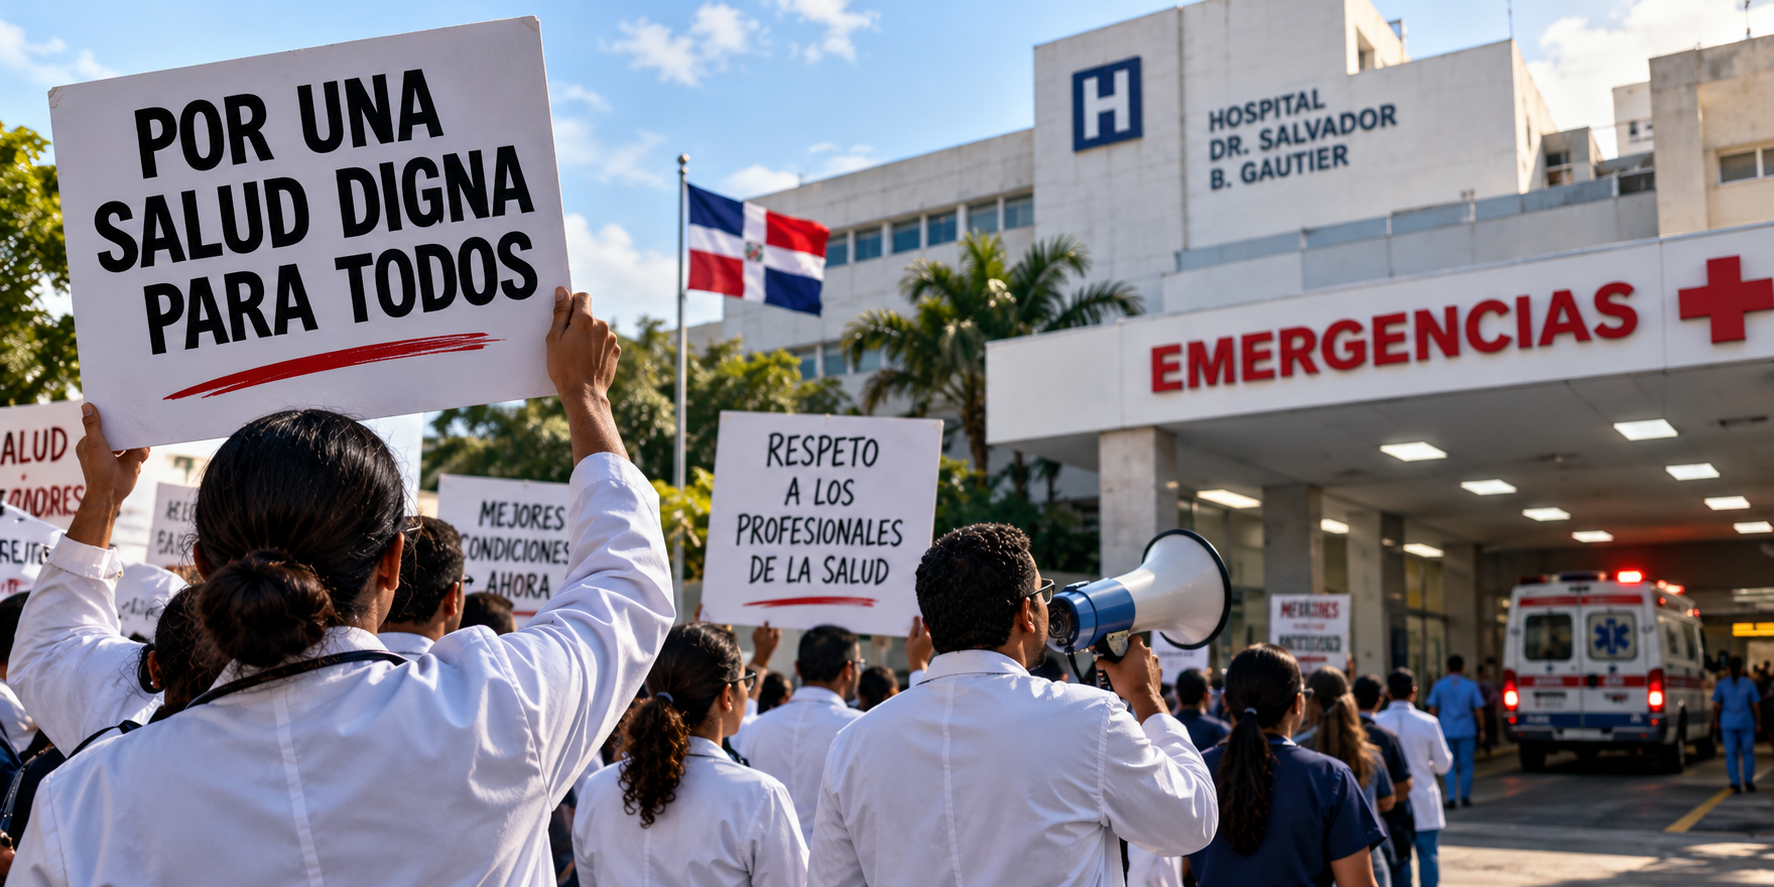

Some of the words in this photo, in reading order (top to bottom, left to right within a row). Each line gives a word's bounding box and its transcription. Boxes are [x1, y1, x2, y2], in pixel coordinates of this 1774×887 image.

[134, 93, 274, 179] POR
[297, 69, 444, 154] UNA
[1083, 68, 1131, 140] H
[1209, 88, 1326, 133] HOSPITAL
[1209, 135, 1249, 162] DR.
[1258, 103, 1398, 151] SALVADOR
[1210, 168, 1232, 191] B.
[1241, 144, 1349, 185] GAUTIER
[94, 176, 310, 273] SALUD
[335, 145, 534, 239] DIGNA
[143, 263, 318, 355] PARA
[335, 230, 538, 324] TODOS
[1150, 281, 1639, 393] EMERGENCIAS
[766, 432, 879, 468] RESPETO
[784, 477, 800, 506] A
[814, 478, 855, 507] LOS
[478, 500, 566, 531] MEJORES
[736, 513, 904, 547] PROFESIONALES
[486, 570, 551, 600] AHORA
[748, 555, 777, 585] DE
[786, 556, 811, 584] LA
[822, 555, 890, 586] SALUD
